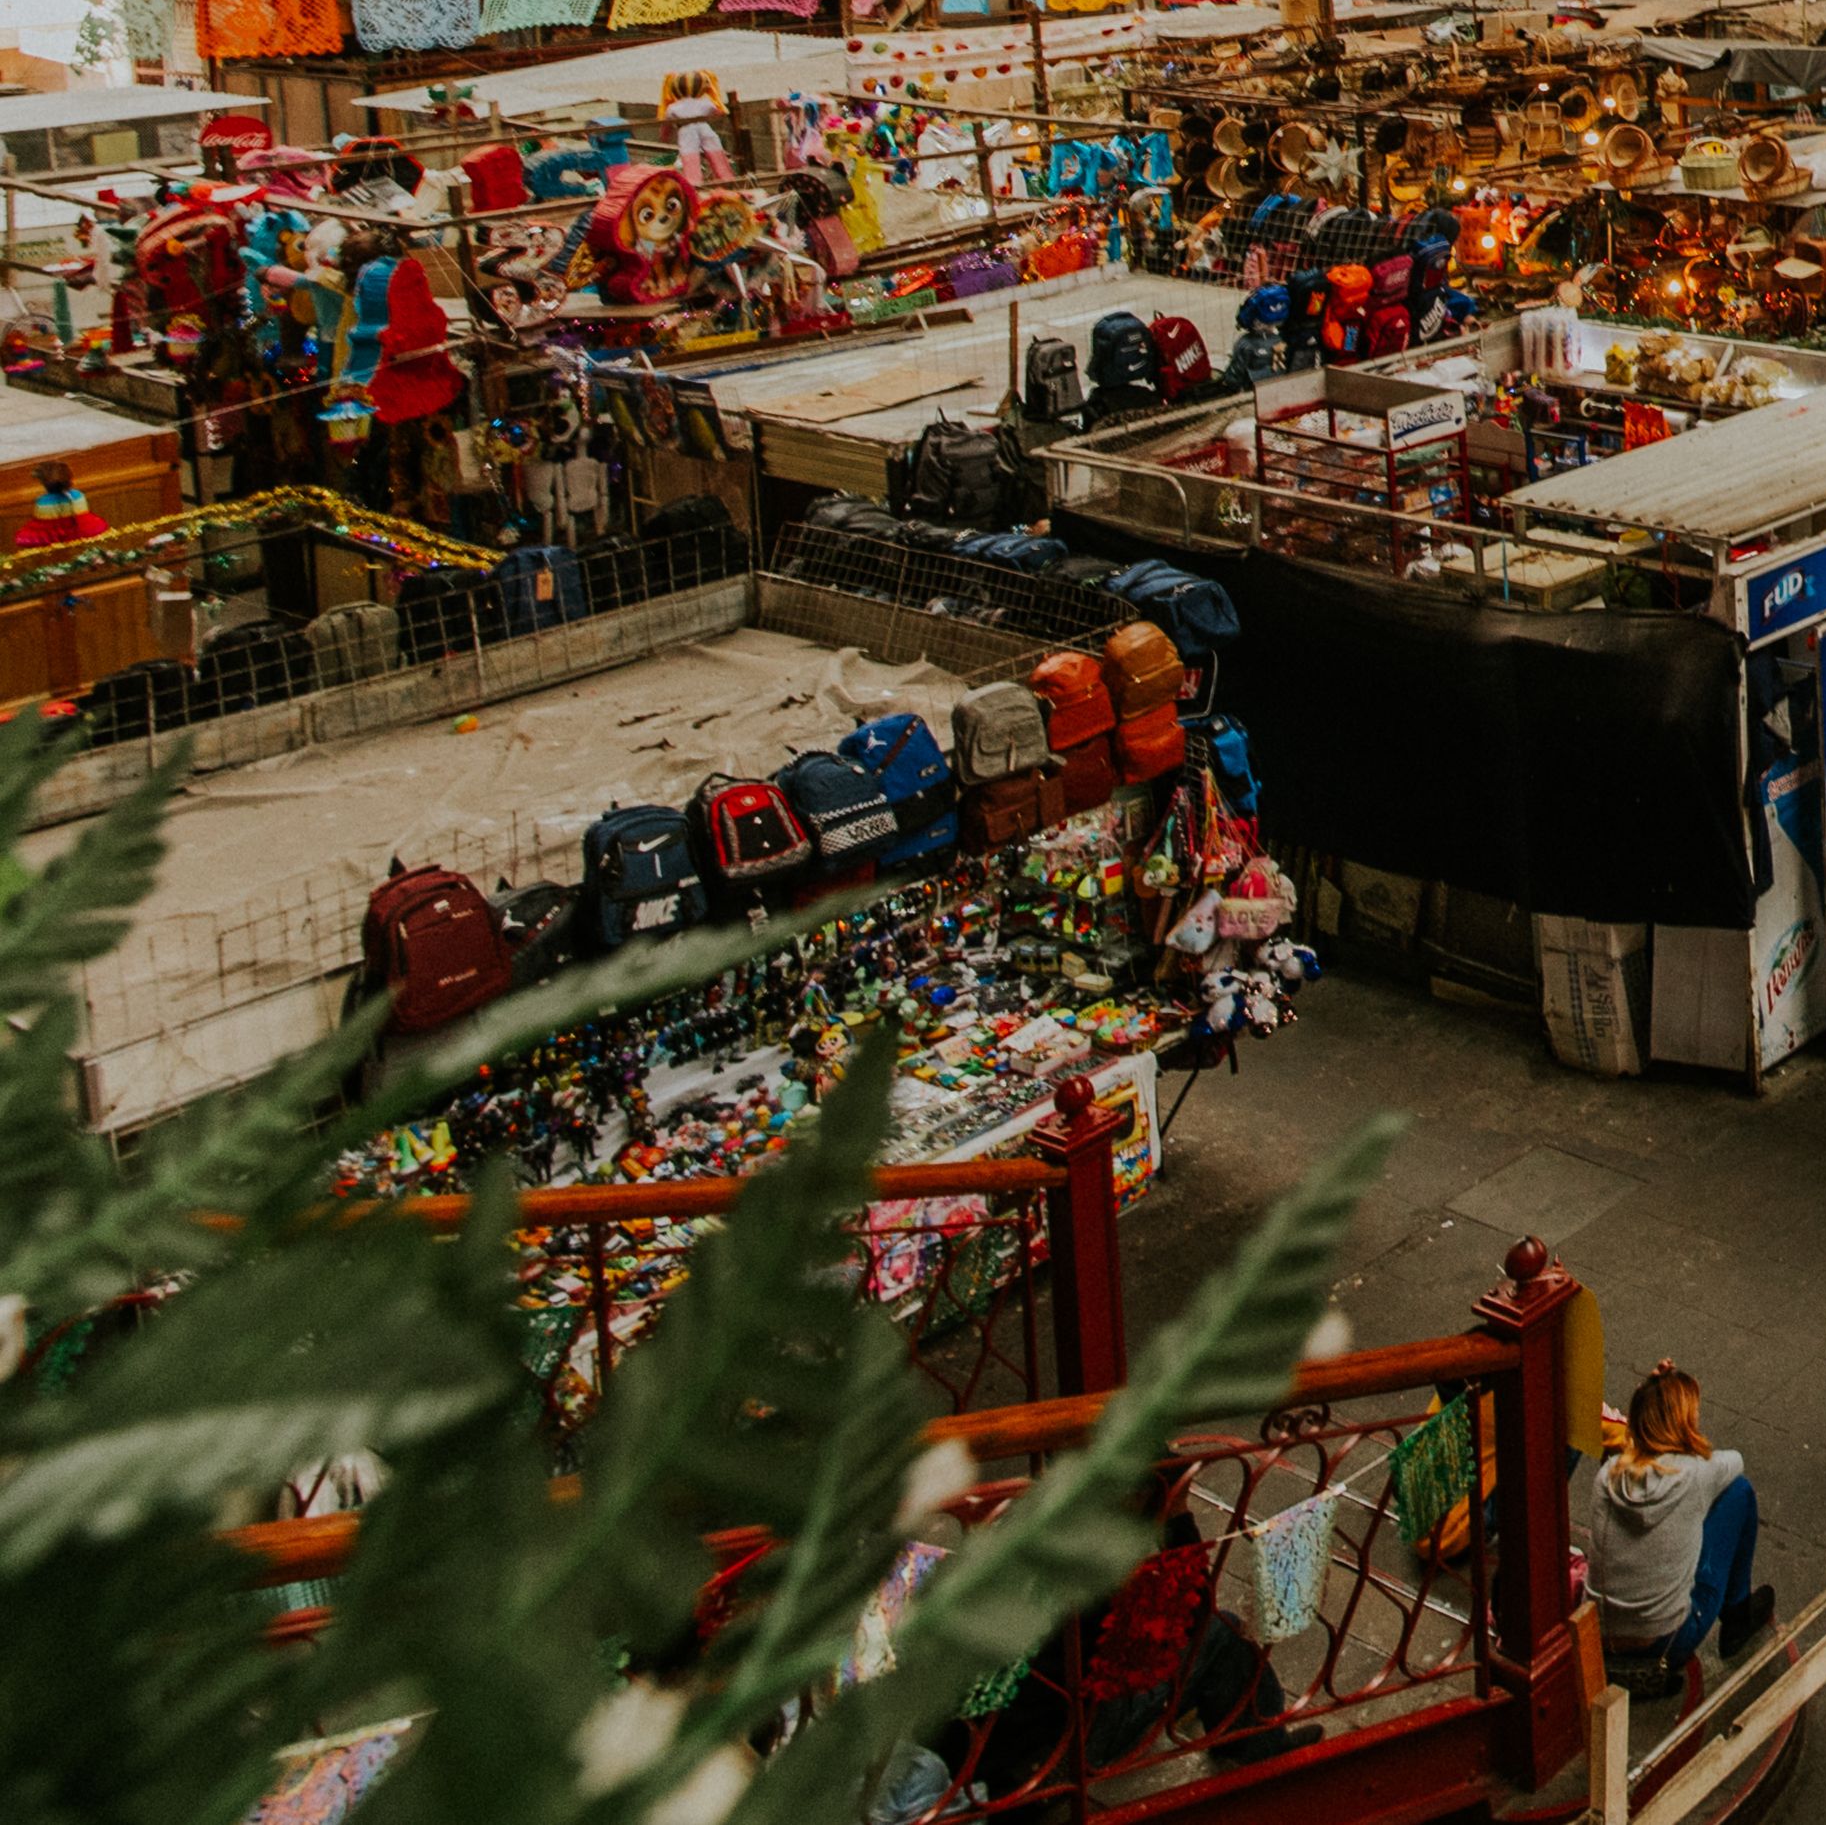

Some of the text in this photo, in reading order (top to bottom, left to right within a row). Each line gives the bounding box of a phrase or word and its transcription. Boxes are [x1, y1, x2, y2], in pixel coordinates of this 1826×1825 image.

[1175, 341, 1202, 374] NIKE
[1763, 570, 1804, 620] FUD
[1224, 909, 1272, 929] LOVE
